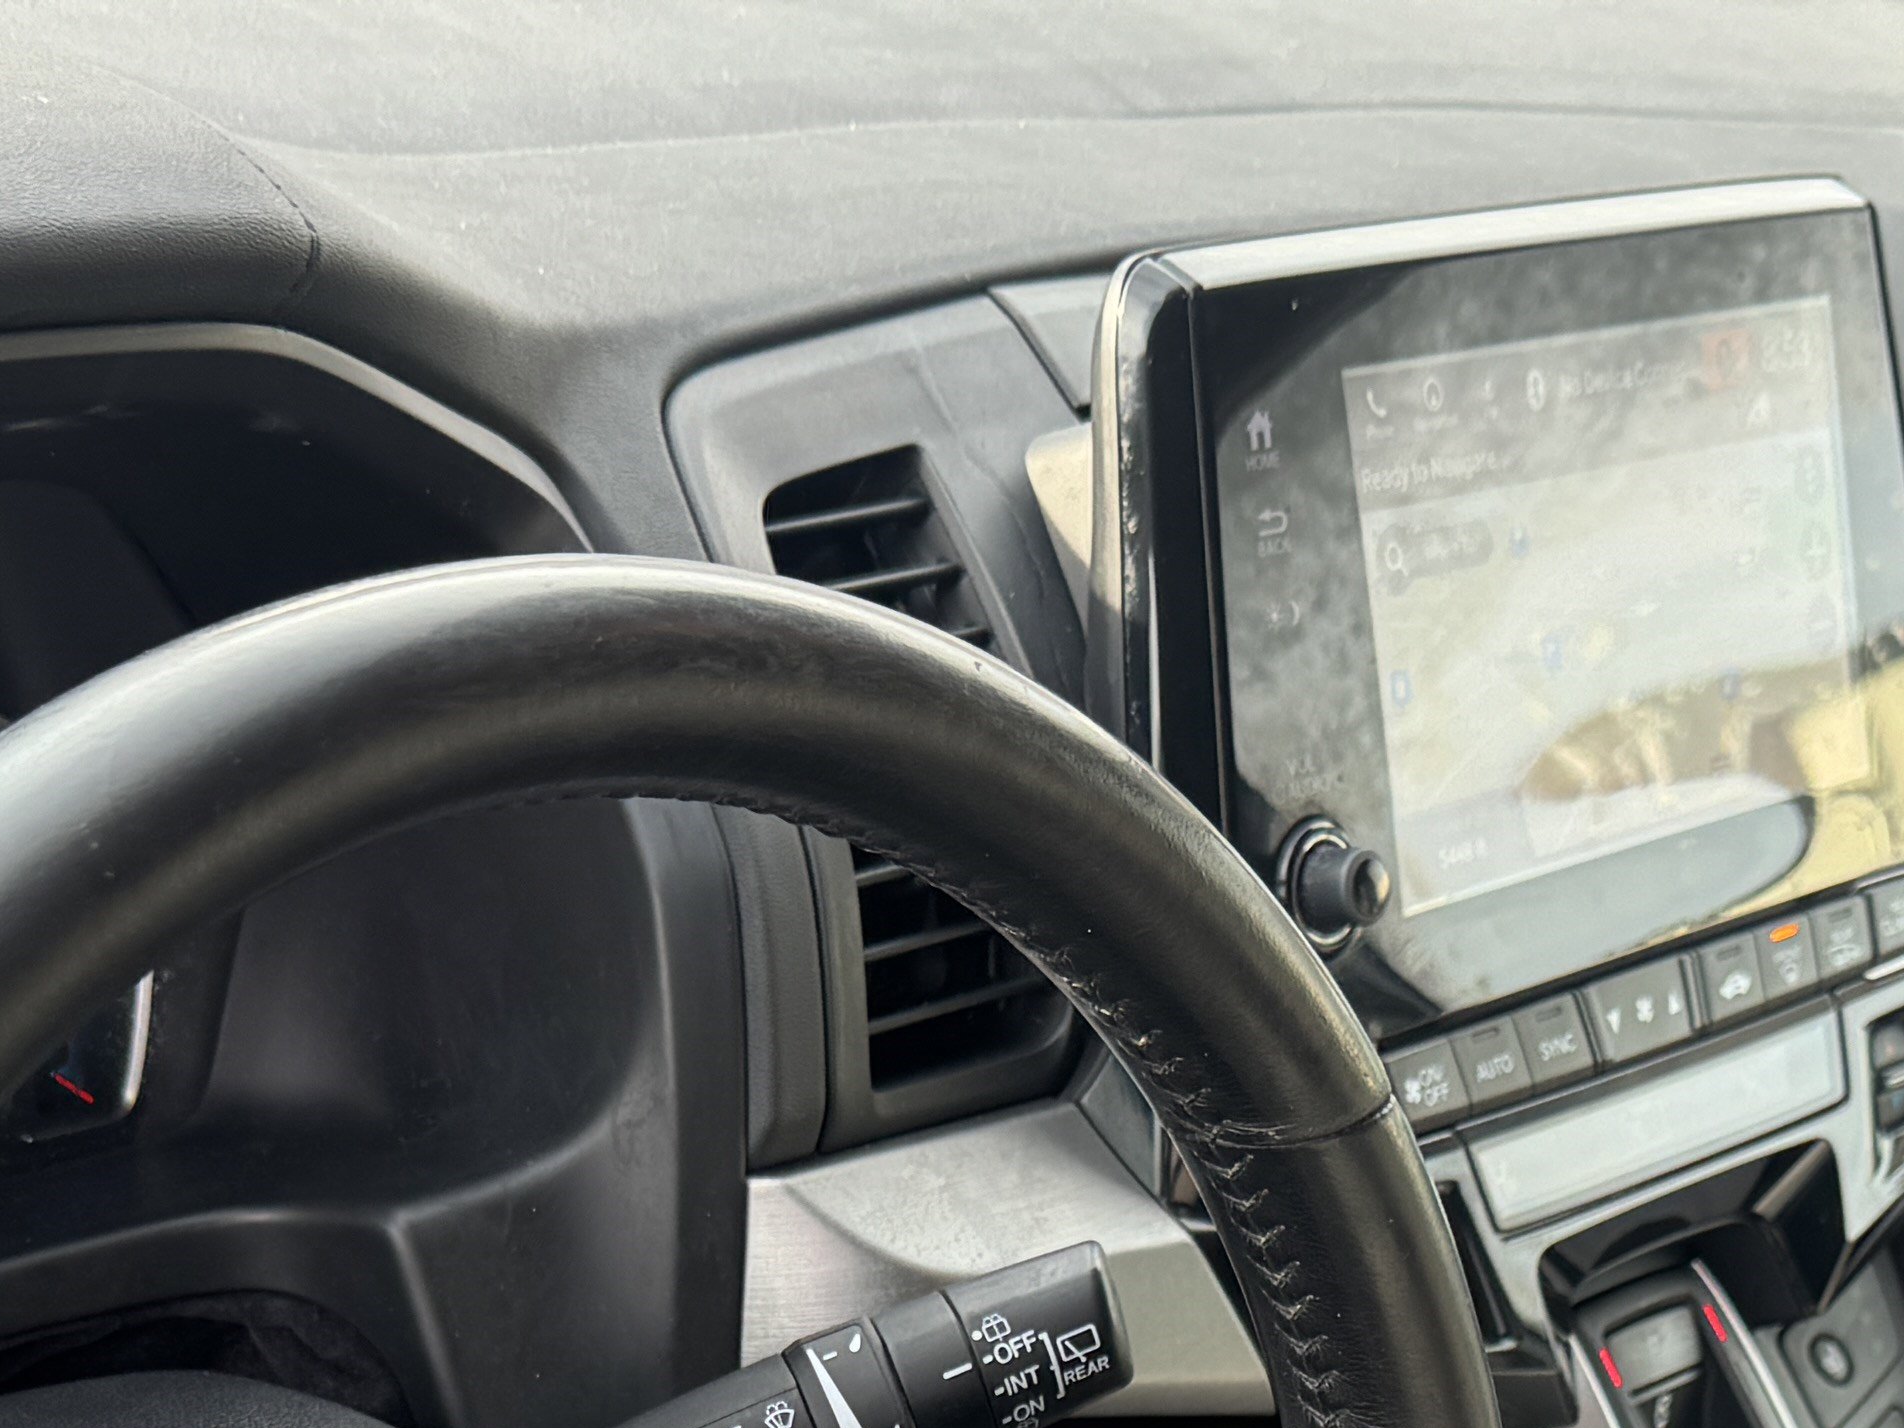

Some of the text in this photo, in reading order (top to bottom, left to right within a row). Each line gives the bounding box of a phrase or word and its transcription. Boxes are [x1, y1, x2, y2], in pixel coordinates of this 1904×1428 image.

[1539, 1033, 1577, 1061] SYNC
[1476, 1053, 1515, 1083] AUTO
[993, 1329, 1037, 1364] OFF
[1003, 1364, 1040, 1397] INT
[1063, 1355, 1110, 1386] REAR
[1013, 1395, 1045, 1422] ON
